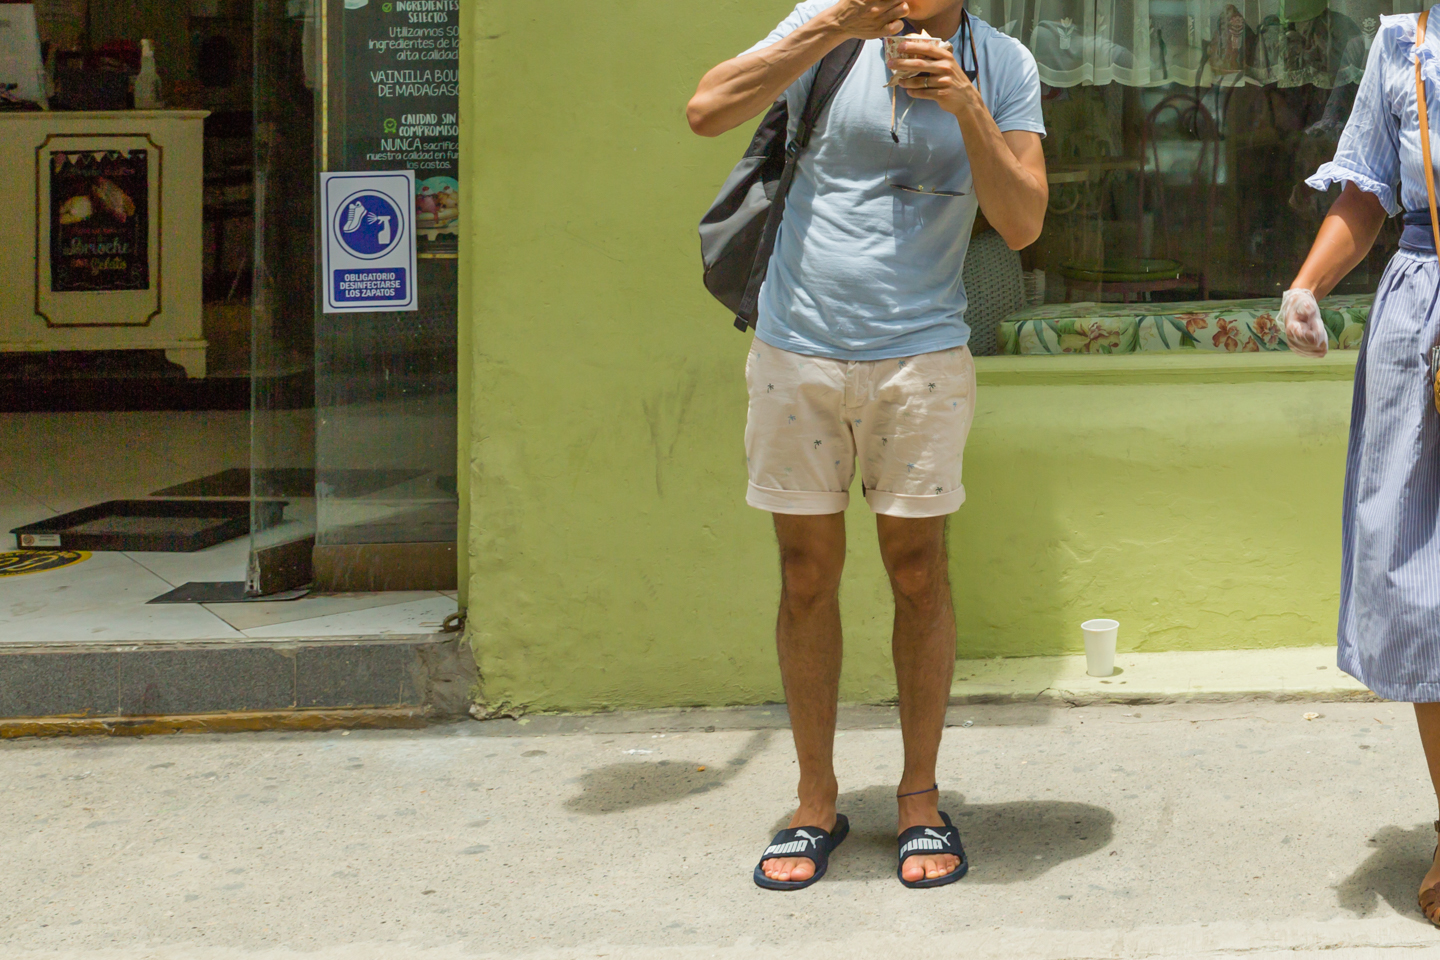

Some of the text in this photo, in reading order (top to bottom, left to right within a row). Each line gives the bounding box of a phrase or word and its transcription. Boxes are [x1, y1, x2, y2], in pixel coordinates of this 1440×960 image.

[396, 0, 459, 12] INGREDIENTES
[408, 11, 448, 23] SELECTOS
[389, 26, 444, 38] Utilizamos
[436, 38, 450, 48] de
[396, 49, 419, 60] alta
[370, 69, 432, 83] VAINILLA
[378, 84, 394, 97] DE
[401, 112, 457, 125] CALIDAD SIN
[398, 124, 459, 137] COMPROMISO
[380, 137, 422, 151] NUNCA
[366, 151, 402, 161] nuestra
[402, 150, 433, 160] calidad
[434, 152, 446, 160] en
[344, 272, 396, 281] OBLIGATORIO
[339, 280, 401, 290] DESINFECTARSE
[345, 288, 396, 298] LOS ZAPATOS
[763, 839, 809, 856] PUMA
[899, 837, 943, 859] PUMA
